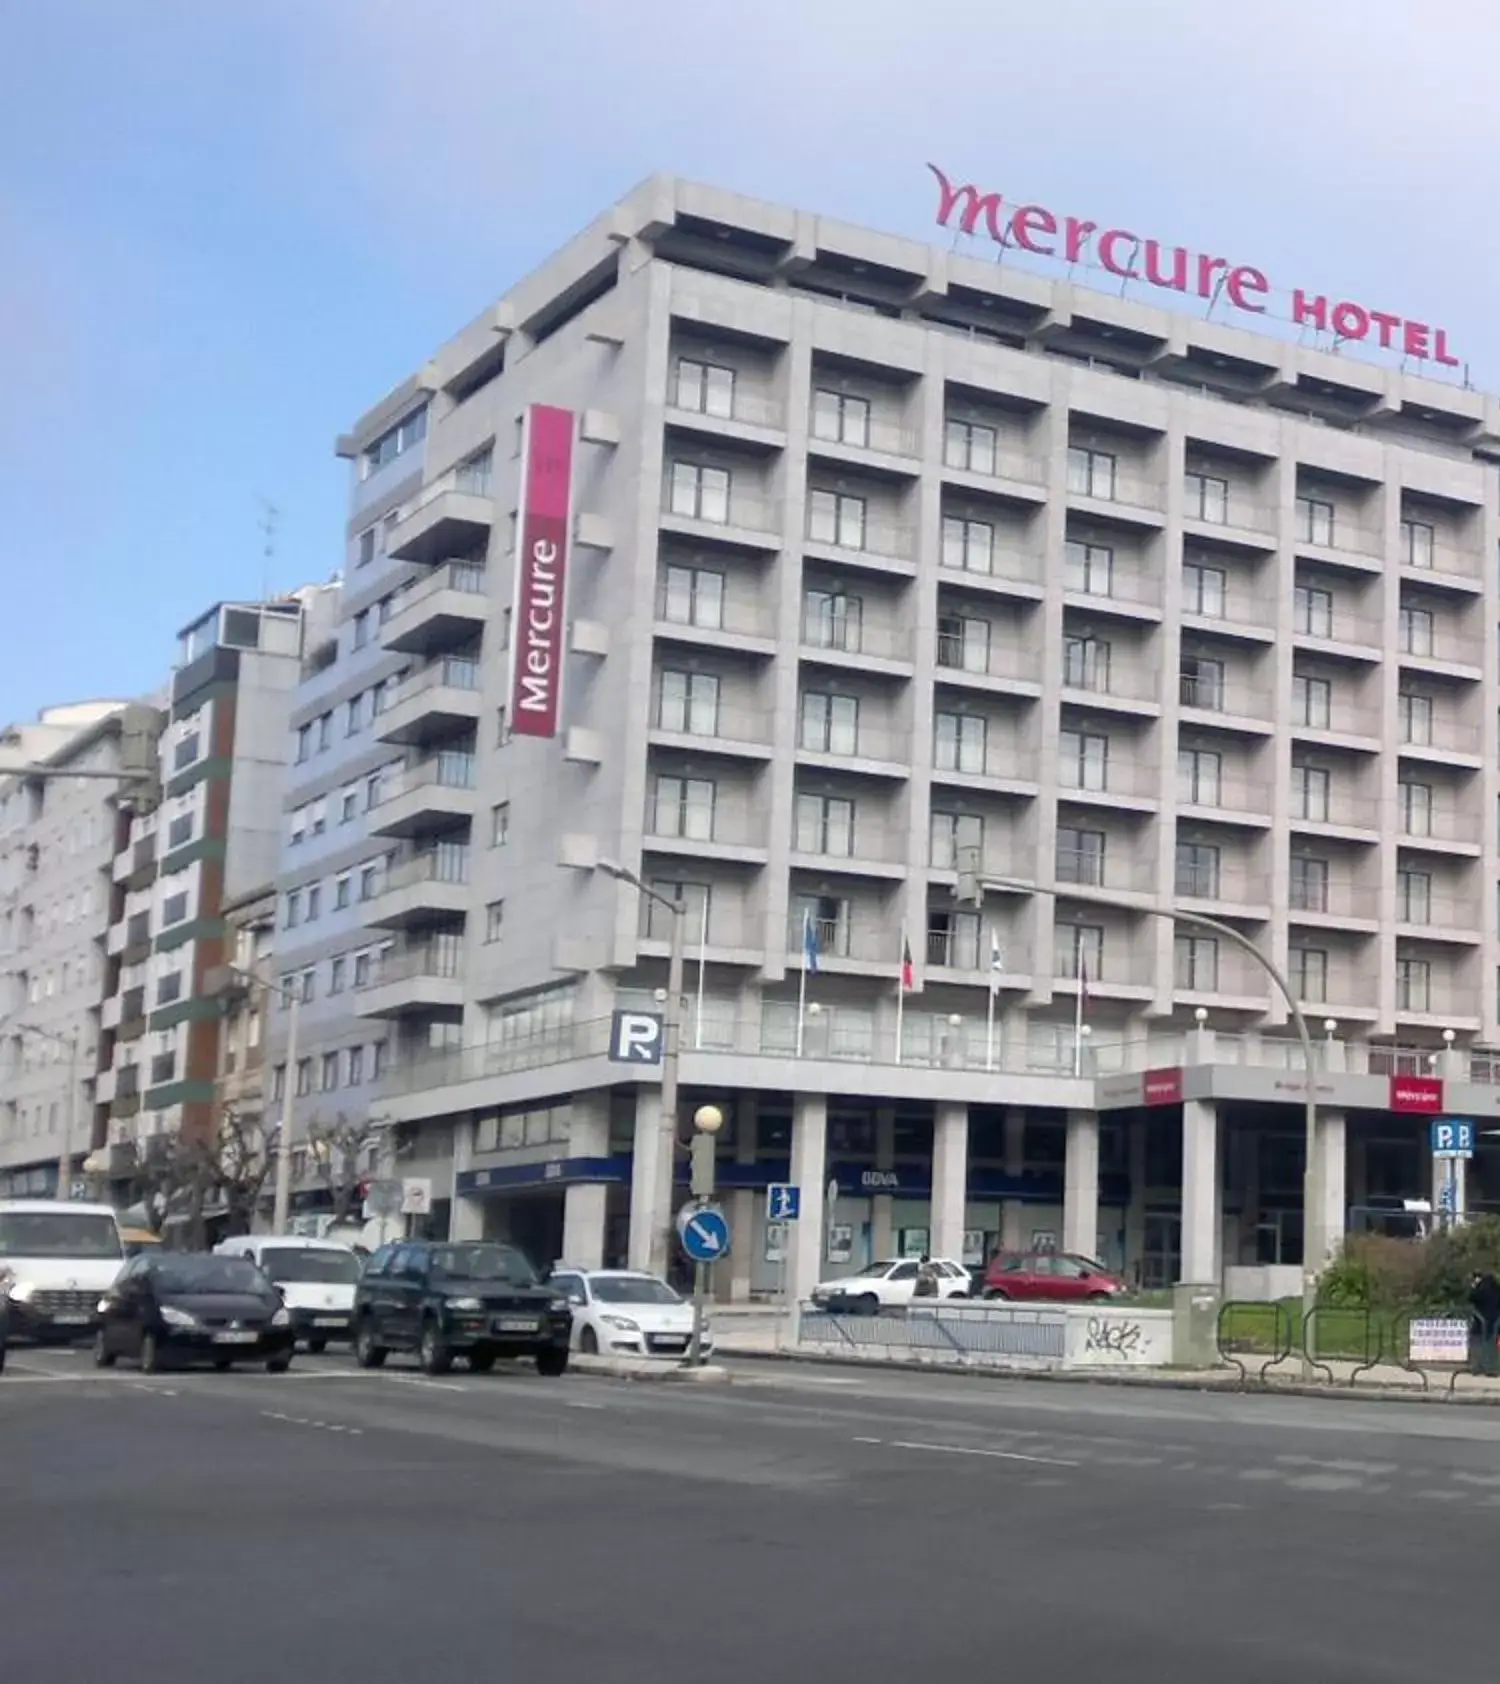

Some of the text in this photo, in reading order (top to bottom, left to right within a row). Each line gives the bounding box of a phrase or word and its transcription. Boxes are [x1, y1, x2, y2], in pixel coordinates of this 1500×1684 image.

[1291, 288, 1459, 367] HOTEL
[519, 538, 557, 713] Mercure
[618, 1015, 658, 1057] P
